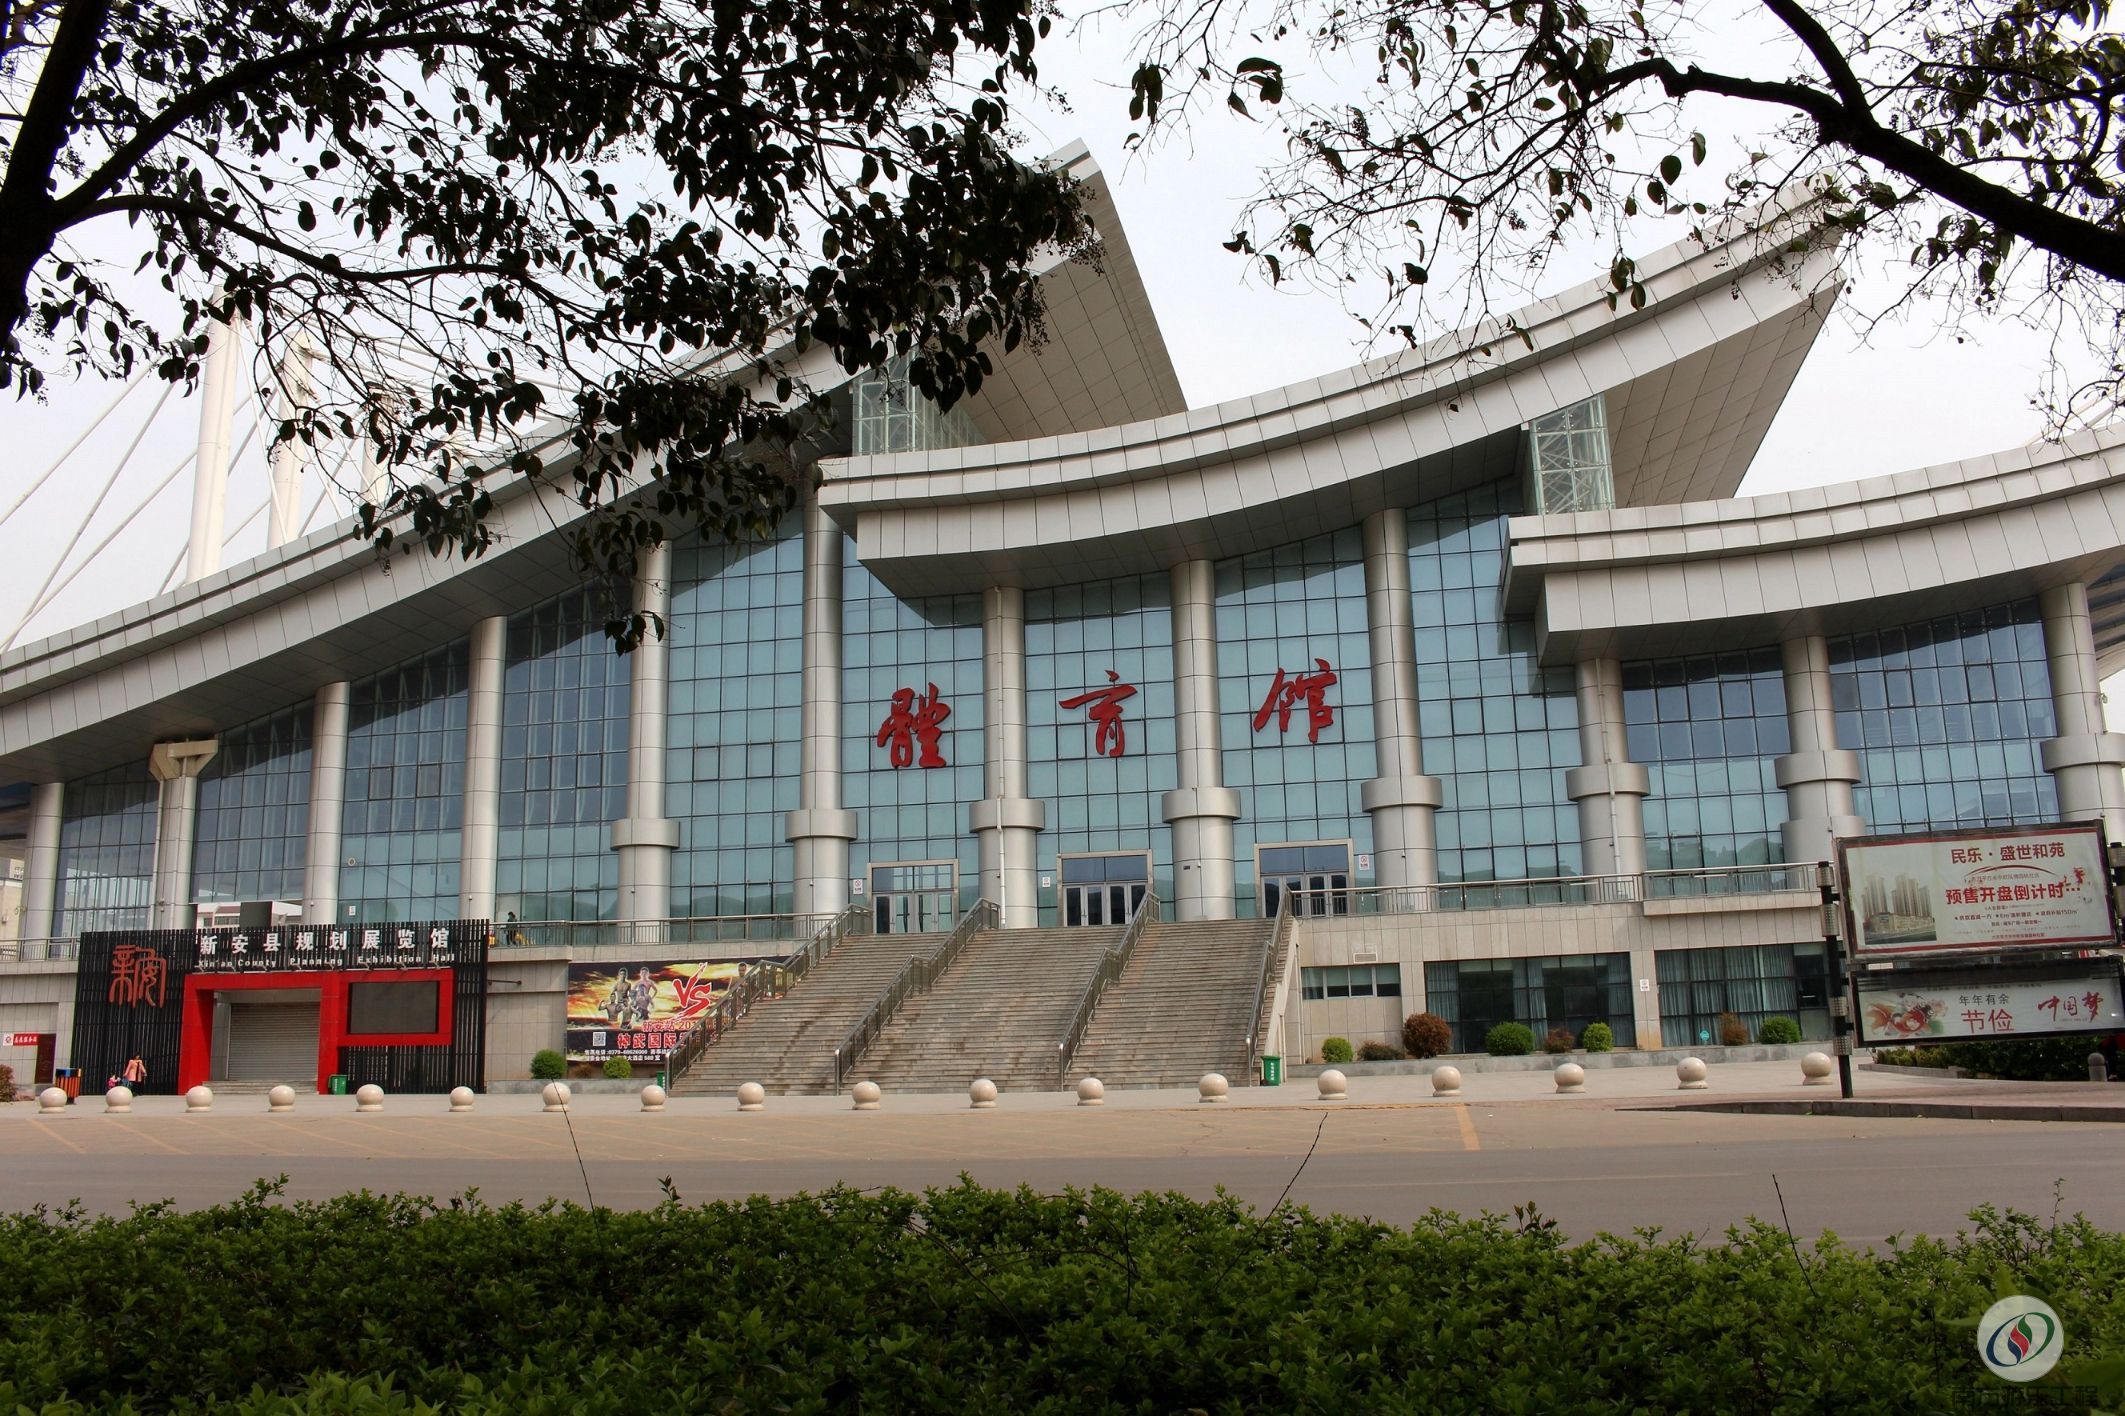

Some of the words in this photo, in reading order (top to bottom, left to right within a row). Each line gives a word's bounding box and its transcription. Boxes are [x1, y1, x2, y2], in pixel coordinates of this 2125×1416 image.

[200, 927, 450, 956] 新安县规划展览馆
[238, 958, 277, 968] County
[290, 957, 343, 967] Planning
[357, 954, 422, 964] Exhibition
[433, 953, 455, 963] Hall
[671, 961, 713, 1020] VS
[1960, 993, 2009, 1006] 年年有余
[2037, 991, 2104, 1023] 中国梦
[1961, 1008, 2014, 1034] 节俭
